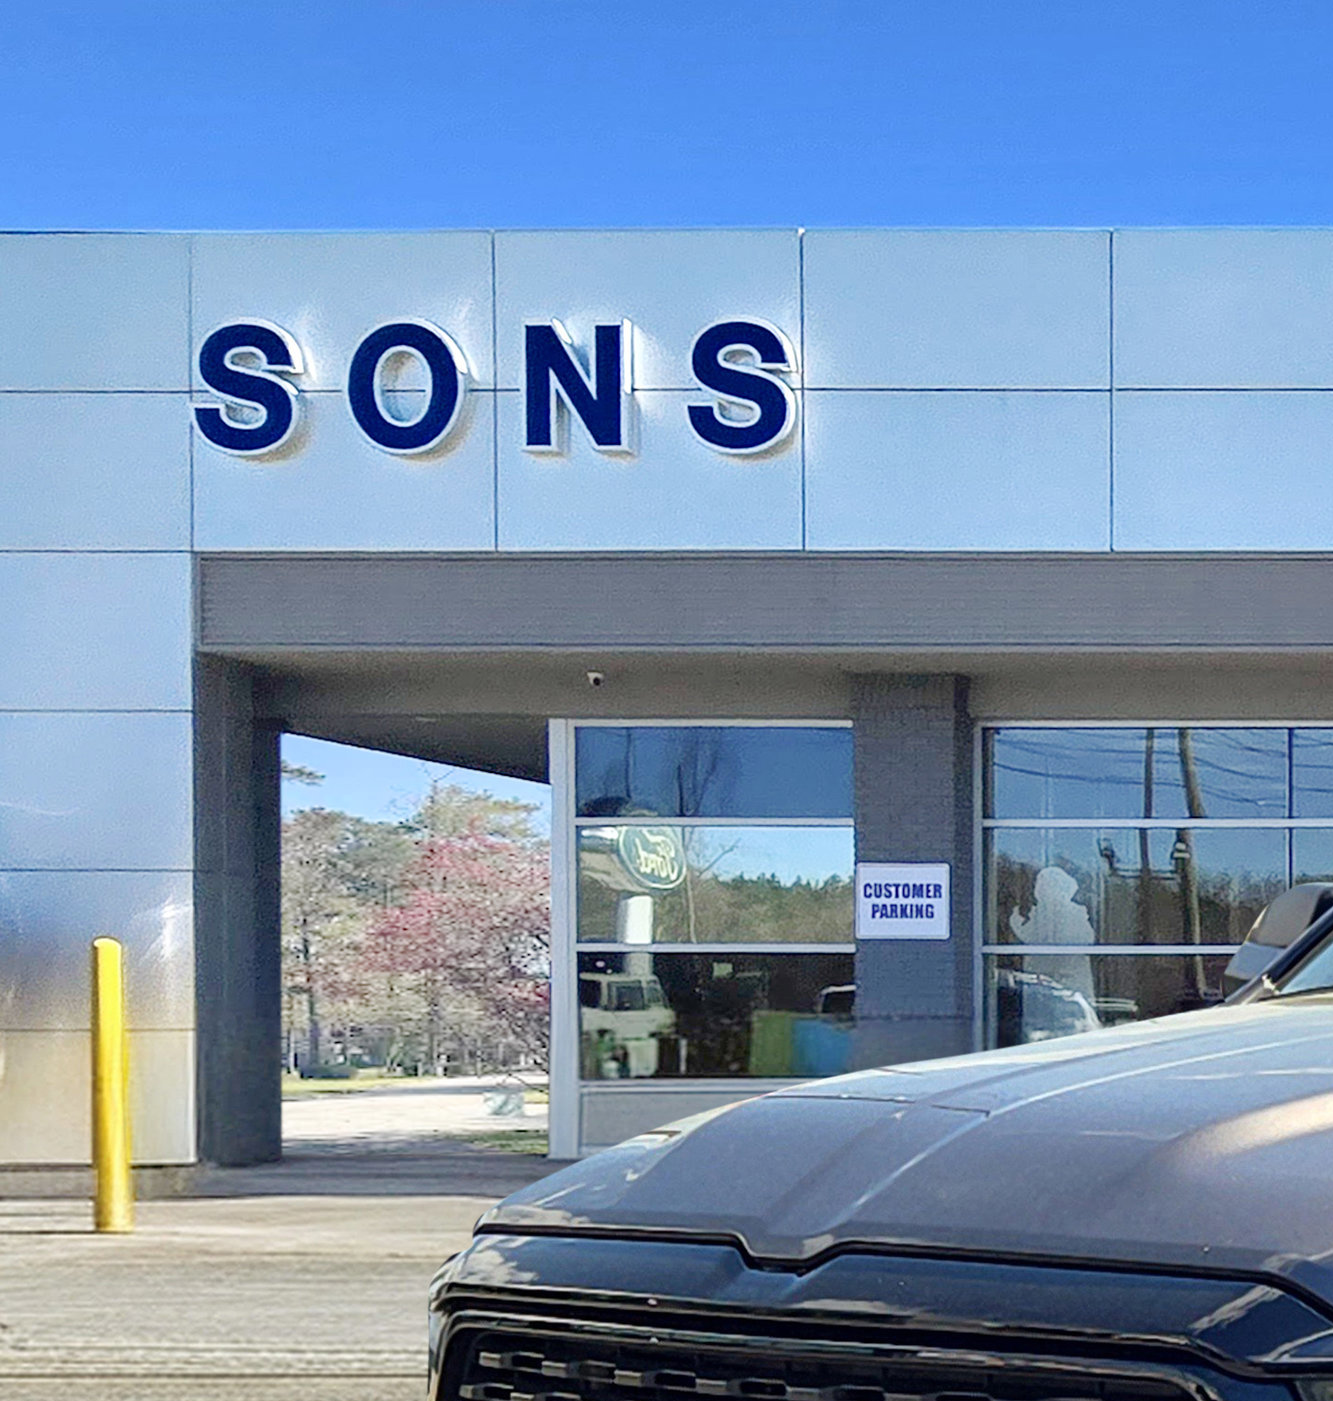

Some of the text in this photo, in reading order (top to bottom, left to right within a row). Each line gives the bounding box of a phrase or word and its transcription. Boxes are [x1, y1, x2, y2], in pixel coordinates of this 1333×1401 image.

[193, 320, 798, 455] SONS
[862, 882, 943, 900] CUSTOMER
[870, 902, 936, 920] PARKING
